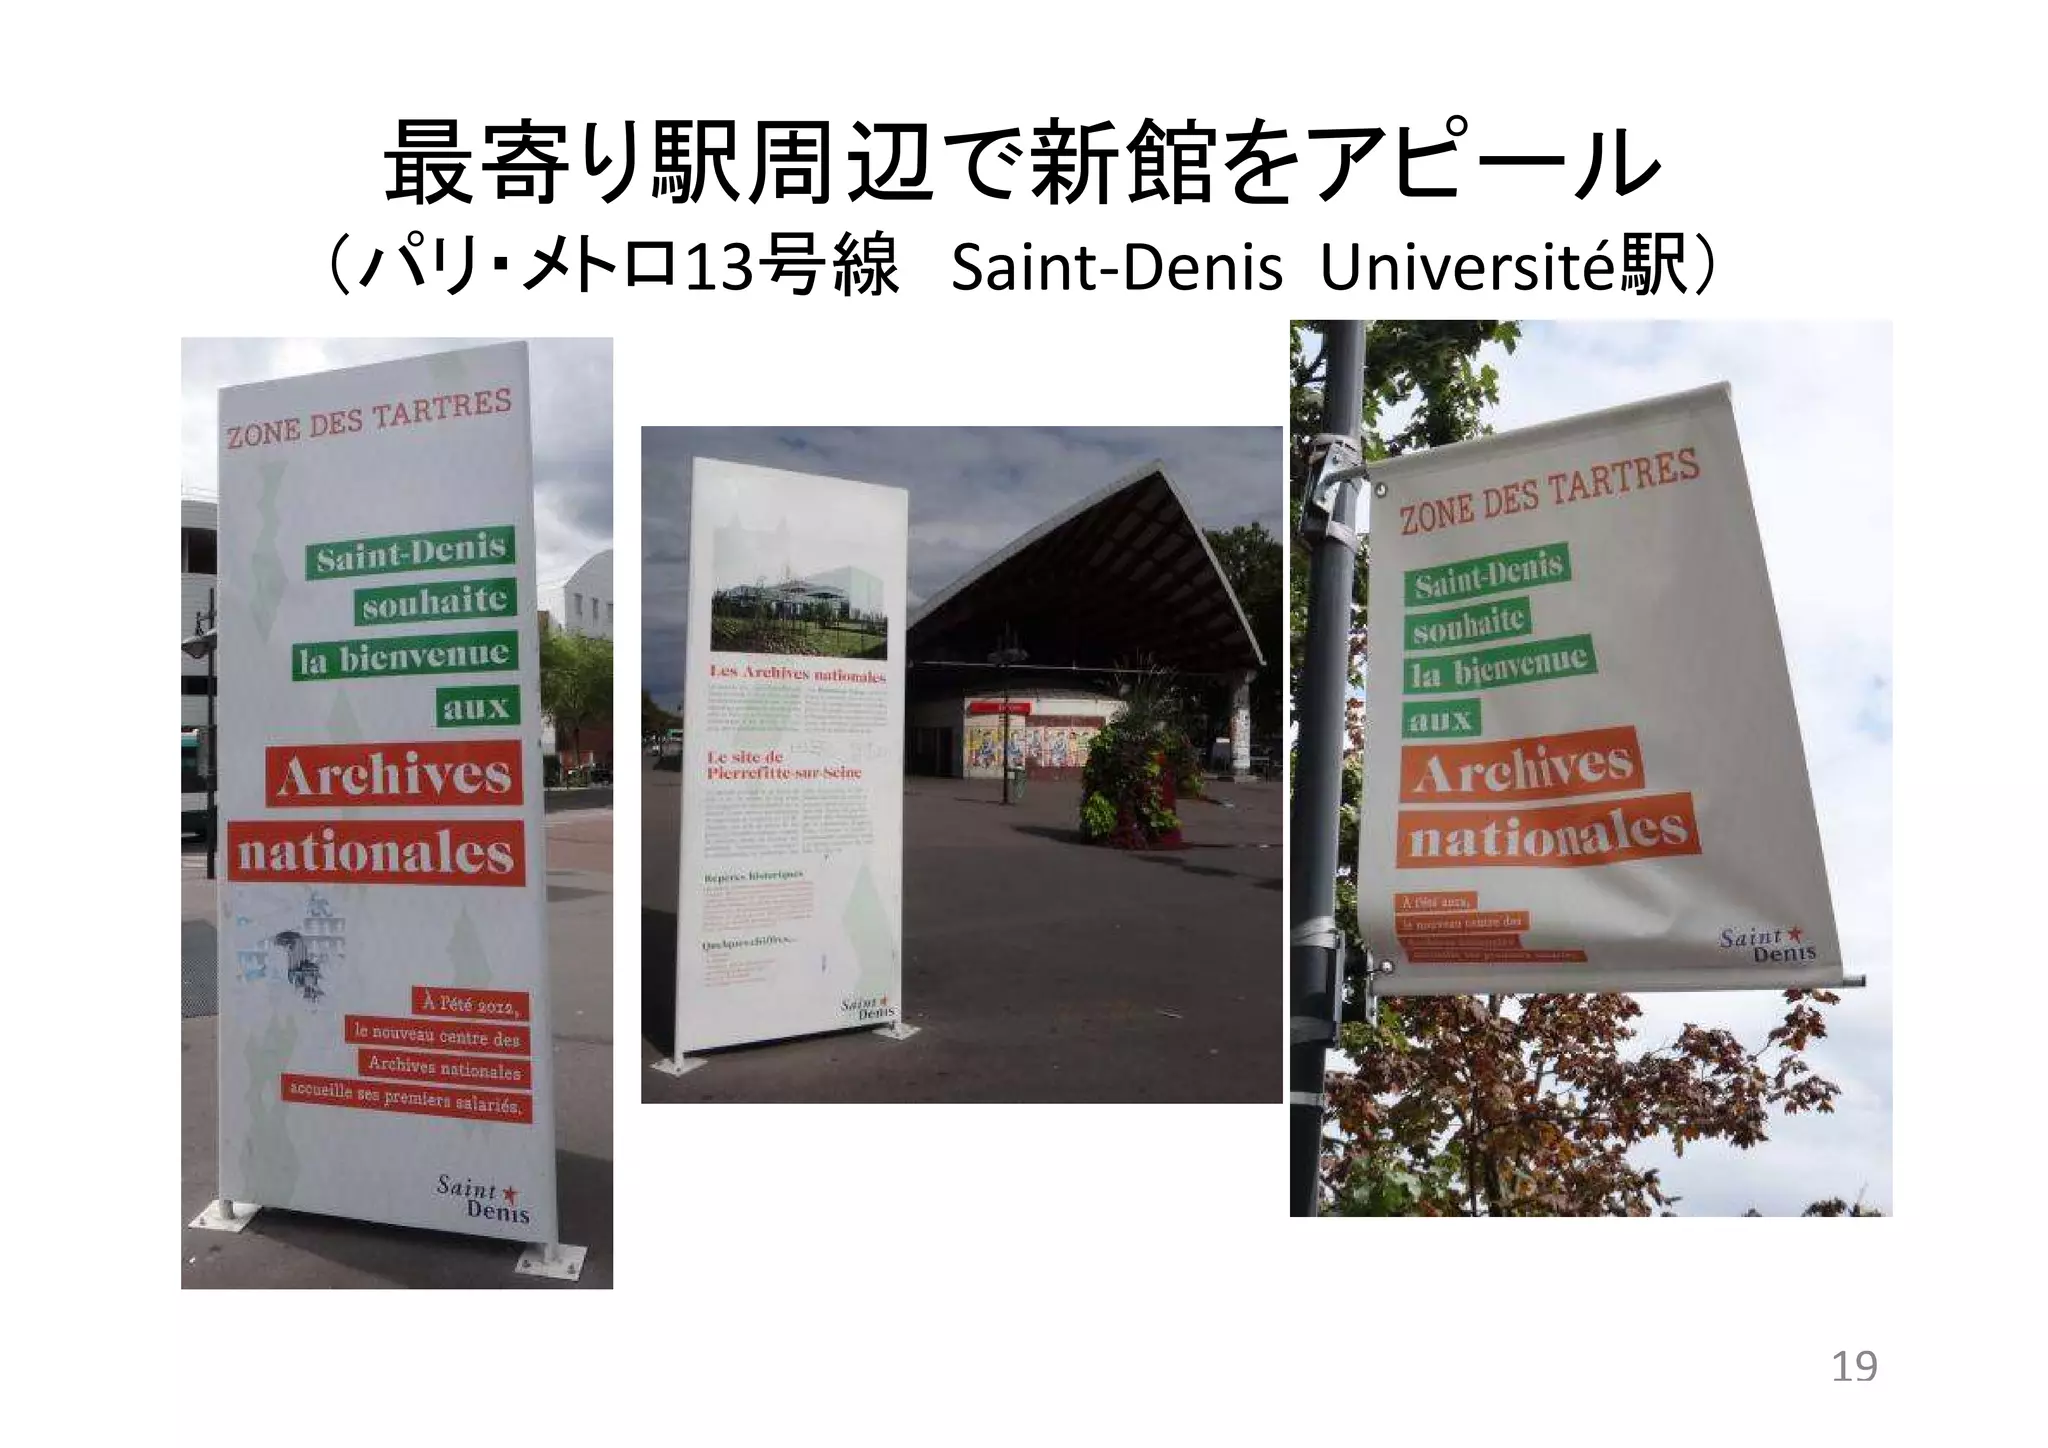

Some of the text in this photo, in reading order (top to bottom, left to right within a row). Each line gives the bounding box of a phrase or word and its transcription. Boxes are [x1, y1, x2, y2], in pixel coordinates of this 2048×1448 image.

[227, 388, 513, 450] ZONE DES TARTRES
[1401, 447, 1700, 535] ZONE DES TARTRES
[316, 532, 507, 573] Saint-Denis
[1415, 550, 1565, 599] Saint-Denis
[362, 587, 508, 621] souhaite
[1413, 607, 1525, 645] souhaite
[300, 641, 510, 676] la bienvenue
[1410, 646, 1588, 688] la bienvenue
[710, 665, 887, 684] Les Archives nationales
[443, 695, 510, 720] aux
[1409, 708, 1472, 733] aux
[707, 750, 784, 764] Le site de
[1413, 743, 1634, 794] Archives
[277, 749, 511, 798] Archives
[1410, 808, 1690, 858] nationales
[238, 828, 515, 875] nationales
[1720, 927, 1783, 948] Saint
[1753, 945, 1817, 964] Denis
[422, 989, 520, 1019] À l'été 2012,
[859, 1007, 895, 1021] Denis
[353, 1021, 521, 1048] le nouveau centre des
[368, 1055, 522, 1081] Archives nationales
[290, 1081, 353, 1099] accueille
[358, 1087, 380, 1101] ses
[384, 1091, 451, 1109] premiers
[436, 1173, 497, 1200] Saint
[467, 1198, 531, 1225] Denis
